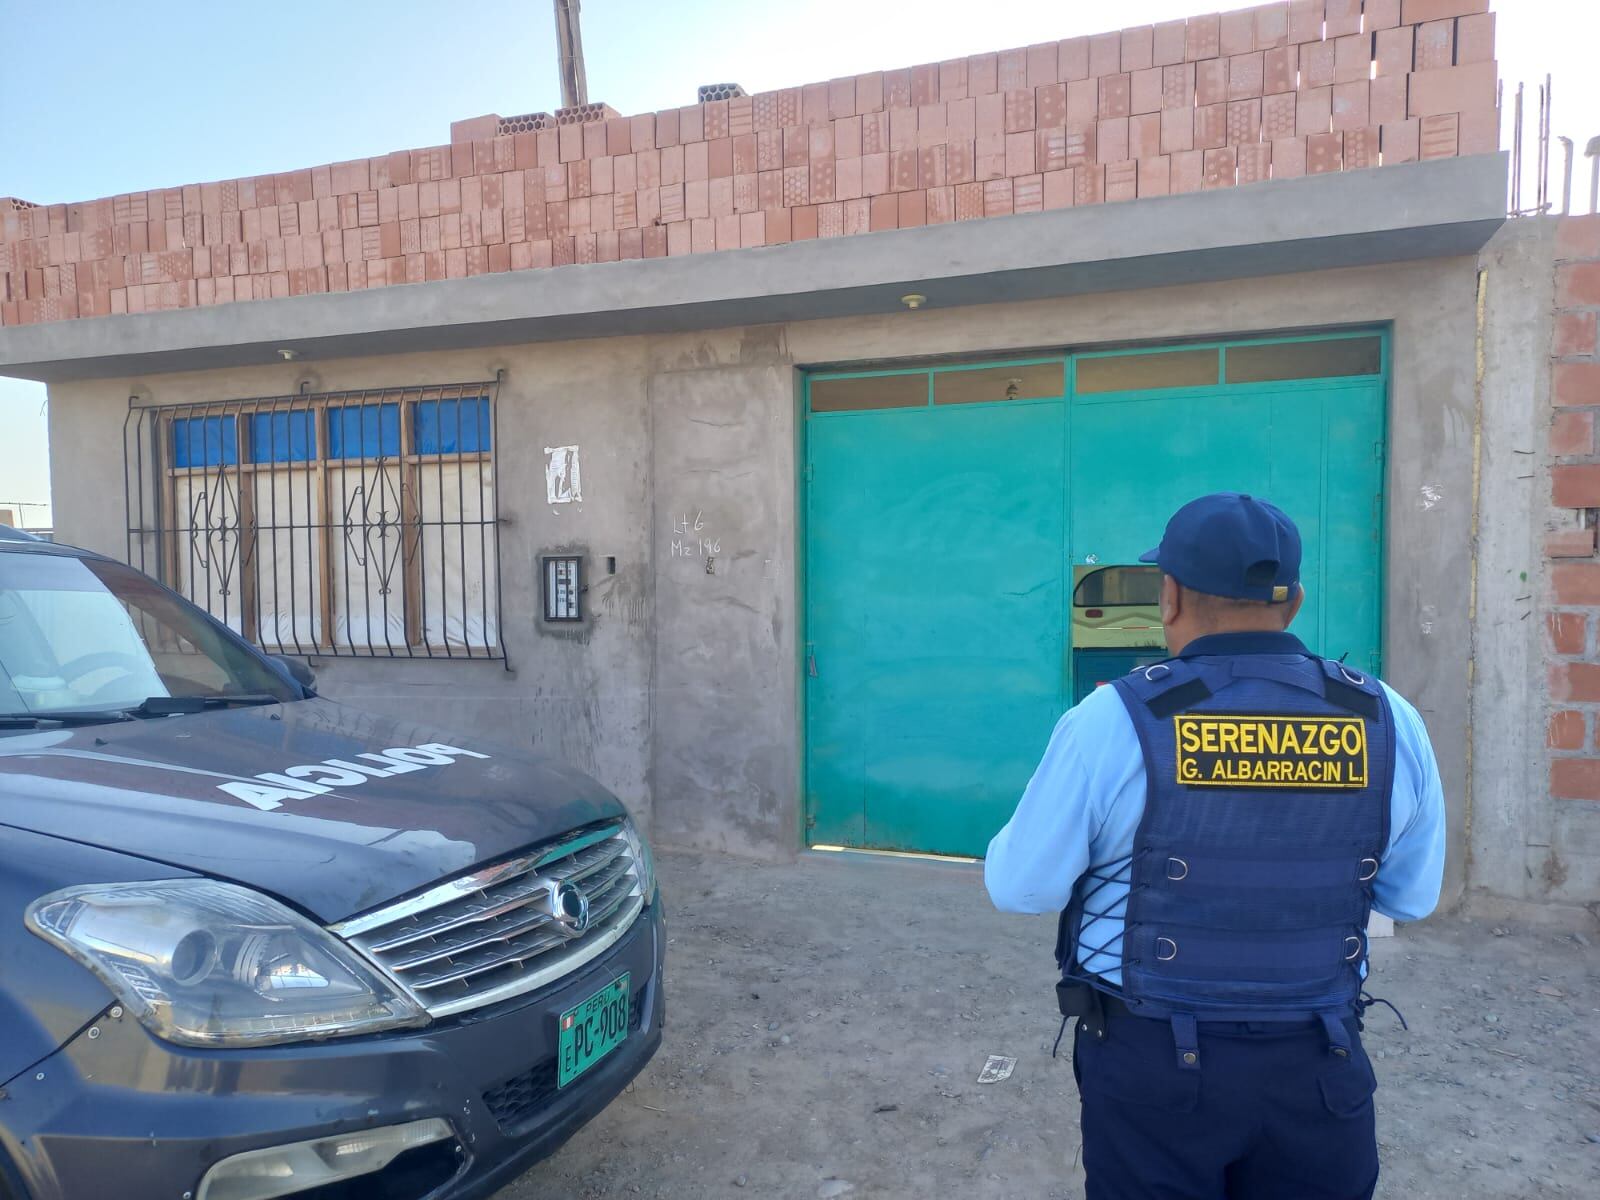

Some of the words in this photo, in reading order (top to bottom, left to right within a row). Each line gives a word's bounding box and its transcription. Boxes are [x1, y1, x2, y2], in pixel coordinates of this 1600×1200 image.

[694, 510, 704, 531] 6
[1181, 721, 1362, 756] SERENAZGO
[1182, 758, 1203, 779] G.
[1211, 759, 1342, 782] ALBARRACIN
